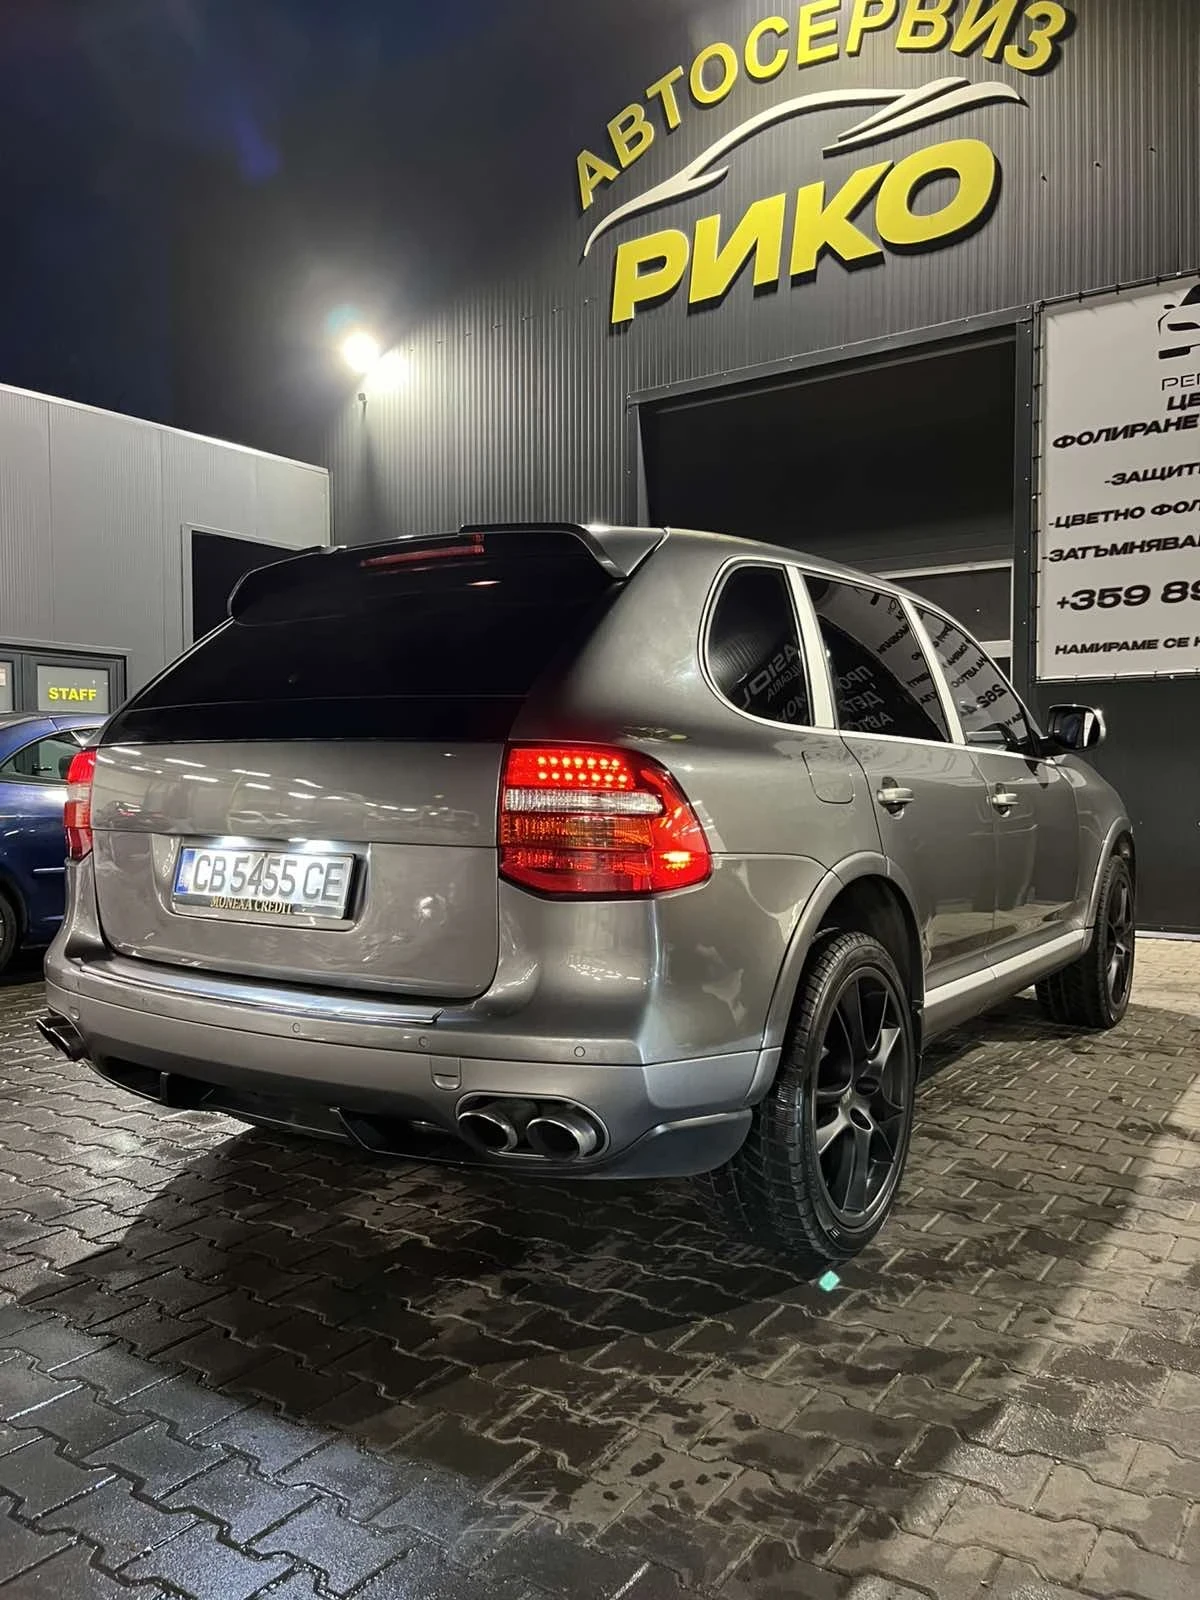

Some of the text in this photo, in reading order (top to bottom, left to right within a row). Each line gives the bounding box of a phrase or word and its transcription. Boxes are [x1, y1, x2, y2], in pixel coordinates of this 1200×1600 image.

[576, 0, 1067, 210] АВТОСЕРВИЗ
[611, 138, 996, 324] РИКО
[1161, 373, 1200, 391] PE
[1053, 414, 1200, 448] ФОЛИРАНЕ
[1104, 462, 1200, 486] -ЗАЩИТ
[1048, 507, 1145, 529] -ЦВЕТНО
[1042, 535, 1200, 562] -ЗАТЪМНЯВА
[1056, 585, 1151, 611] +359
[1055, 638, 1159, 655] НАМИРАМЕ
[1163, 636, 1190, 648] СЕ
[48, 687, 97, 701] STAFF
[230, 856, 297, 897] 5455
